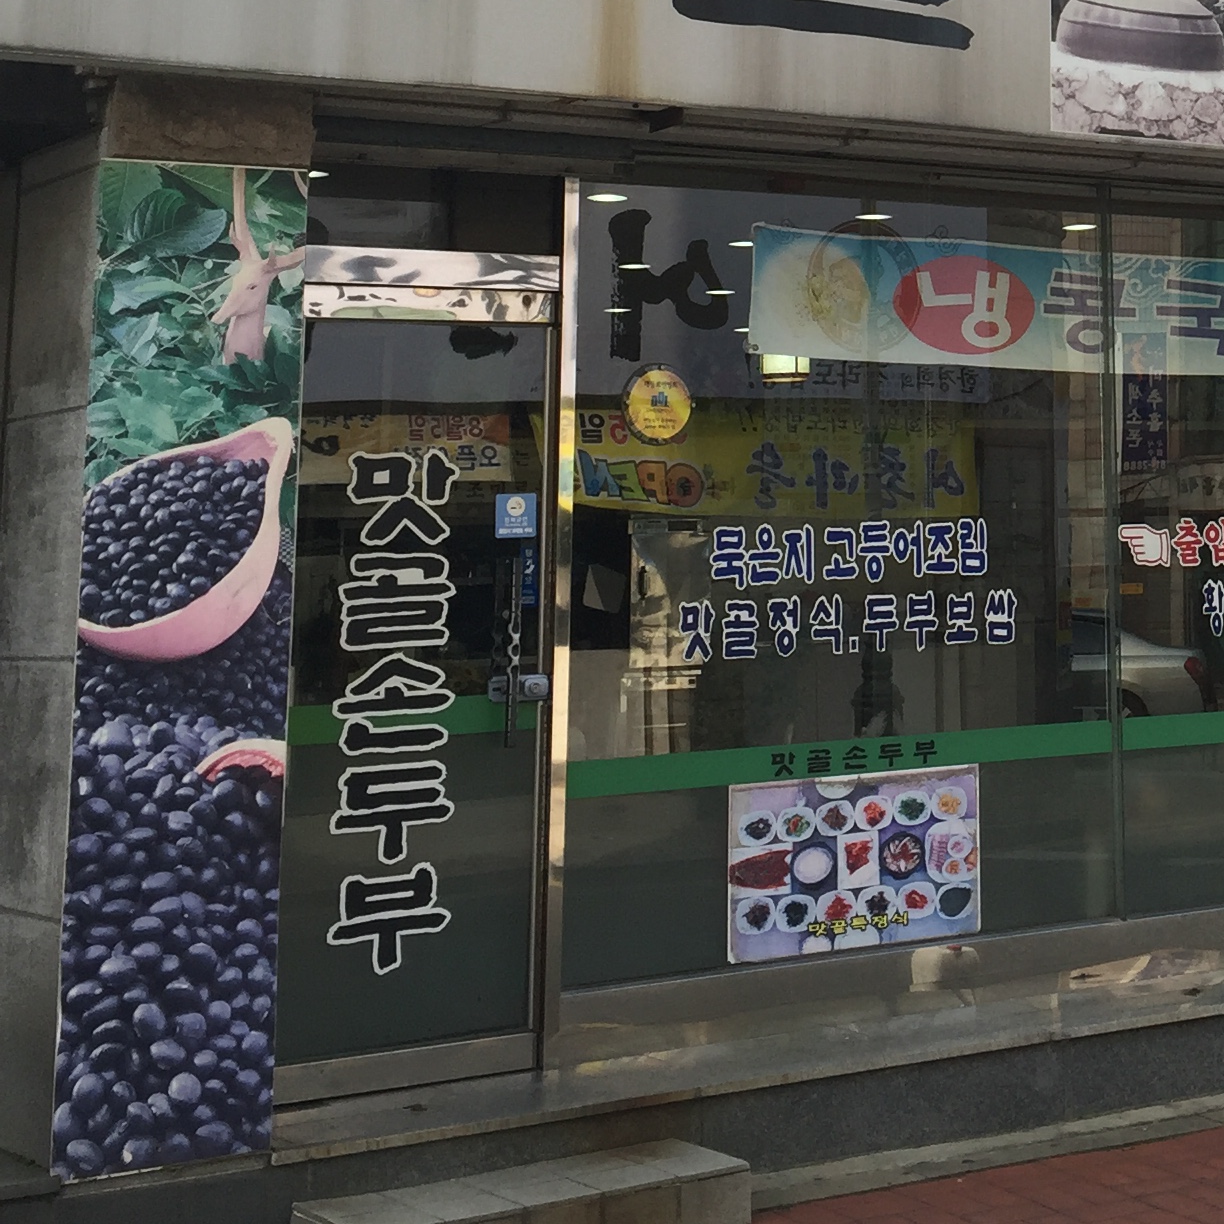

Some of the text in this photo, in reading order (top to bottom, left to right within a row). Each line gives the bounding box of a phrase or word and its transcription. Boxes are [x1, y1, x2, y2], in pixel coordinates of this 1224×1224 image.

[709, 517, 989, 591] 묵은지 고등어조림
[326, 448, 461, 976] 맛골손두부
[770, 739, 938, 777] 맛골손두부
